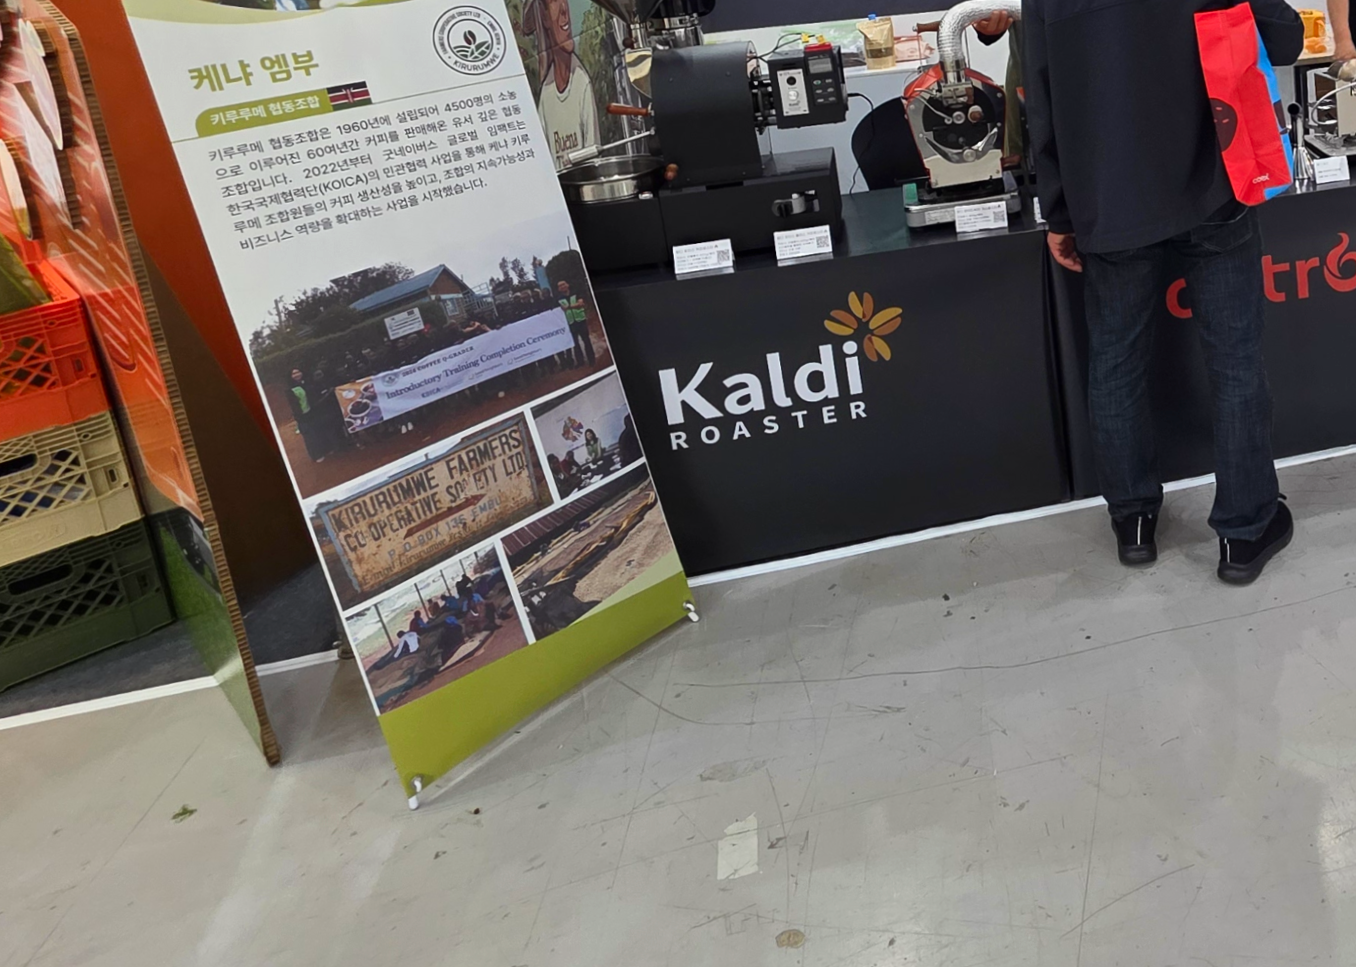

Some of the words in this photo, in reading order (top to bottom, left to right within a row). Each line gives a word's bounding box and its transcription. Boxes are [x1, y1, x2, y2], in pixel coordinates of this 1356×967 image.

[188, 60, 253, 92] 케냐
[260, 50, 320, 80] 엠부
[452, 52, 500, 72] KIRURUMWE
[208, 141, 265, 162] 키루루메
[268, 127, 332, 150] 협동조합은
[336, 115, 392, 135] 1960년에
[396, 105, 440, 124] 설립되어
[444, 93, 494, 113] 4500명의
[498, 90, 517, 103] 소농
[210, 106, 267, 126] 키루루메
[268, 95, 321, 116] 협동조합
[215, 164, 244, 180] 으로
[249, 151, 302, 172] 이루어진
[306, 138, 361, 160] 60여년간
[365, 130, 400, 148] 커피를
[404, 120, 448, 139] 판매해온
[452, 114, 474, 128] 유서
[477, 109, 499, 123] 깊은
[501, 104, 522, 118] 협동
[553, 130, 579, 154] Buena
[220, 173, 293, 198] 조합입니다.
[302, 154, 373, 179] 2022년부터
[382, 139, 438, 162] 굿네이버스
[447, 129, 479, 147] 글로벌
[487, 120, 527, 138] 임팩트는
[226, 168, 381, 217] 한국국제협력단(KOICA)의
[383, 157, 428, 179] 민관협력
[431, 150, 463, 167] 사업을
[464, 143, 486, 159] 통해
[488, 137, 509, 152] 케냐
[511, 133, 531, 147] 키루
[233, 216, 262, 234] 루메
[264, 200, 328, 227] 조합원들의
[329, 193, 355, 209] 커피
[357, 181, 404, 203] 생산성을
[405, 172, 442, 191] 높이고,
[443, 163, 476, 180] 조합의
[476, 148, 536, 171] 지속가능성과
[239, 229, 294, 251] 비즈니스
[295, 217, 333, 236] 역량을
[335, 205, 383, 225] 확대하는
[386, 194, 420, 213] 사업을
[421, 177, 488, 202] 시작했습니다.
[385, 373, 442, 400] Introductory
[442, 359, 480, 378] Training
[479, 340, 527, 365] Completion
[526, 324, 567, 346] Ceremony
[658, 340, 864, 426] Kaldi
[670, 400, 868, 451] ROASTER
[331, 467, 440, 532] KIRURUMWE
[445, 428, 523, 480] FARMERS
